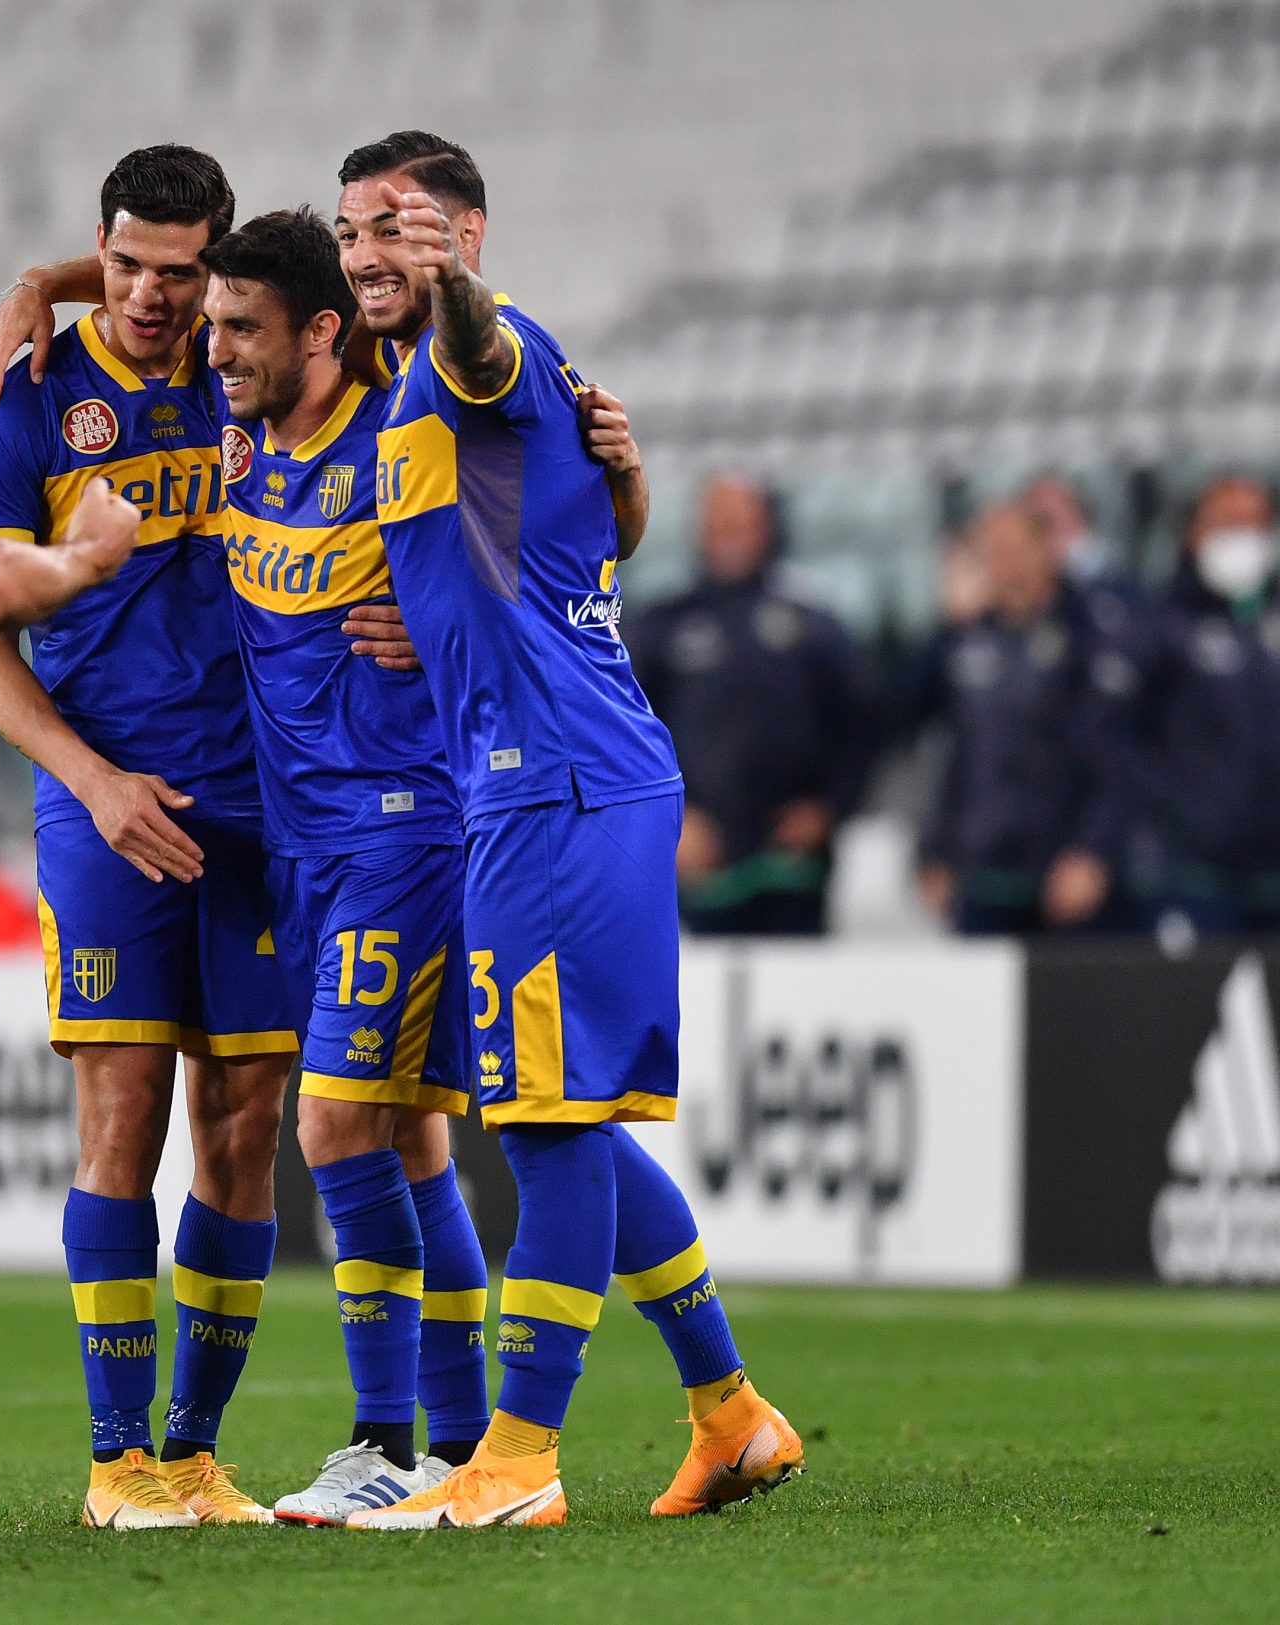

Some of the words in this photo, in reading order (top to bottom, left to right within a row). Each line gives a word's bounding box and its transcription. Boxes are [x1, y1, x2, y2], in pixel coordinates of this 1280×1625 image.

[72, 404, 101, 424] OLD
[70, 415, 109, 437] WILD
[72, 428, 112, 448] WEST
[336, 930, 400, 1006] 15
[469, 950, 500, 1029] 3
[87, 1334, 157, 1358] PARMA
